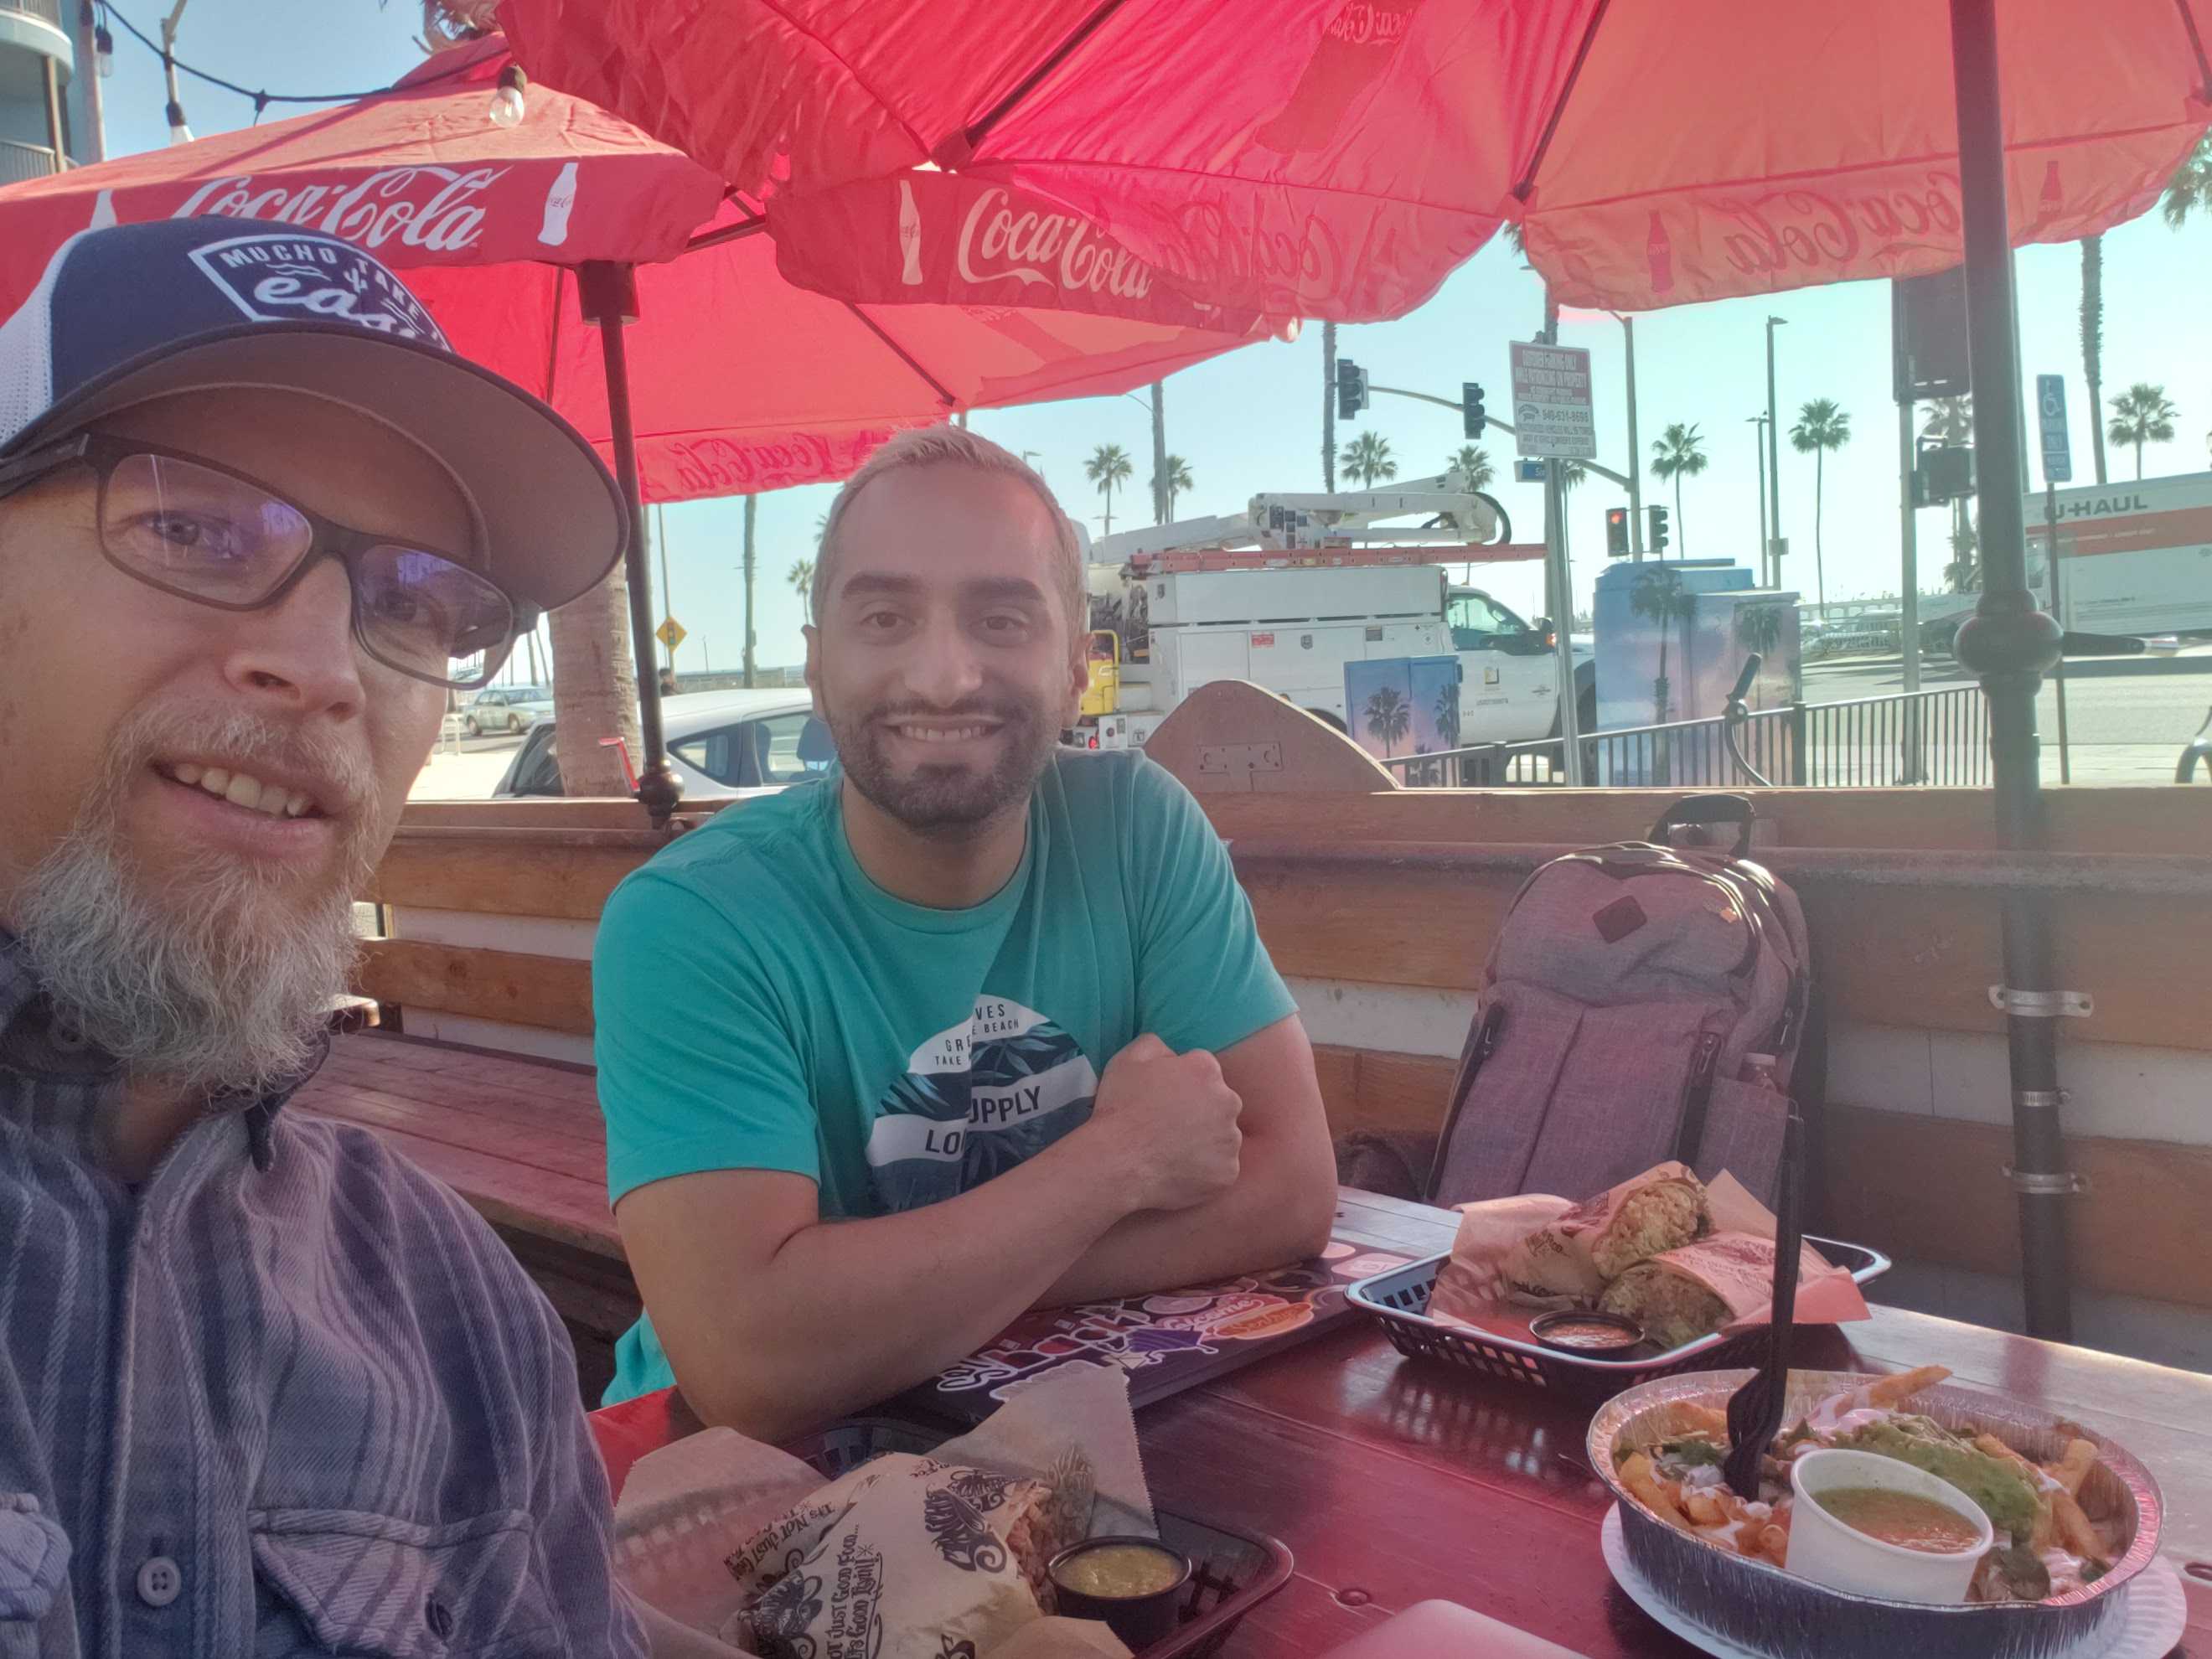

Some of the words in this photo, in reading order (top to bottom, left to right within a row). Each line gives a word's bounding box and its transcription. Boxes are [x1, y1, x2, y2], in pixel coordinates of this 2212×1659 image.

[171, 166, 513, 251] Coca-Cola
[219, 244, 338, 269] MUCHO
[355, 258, 421, 321] TAKE
[2044, 495, 2148, 521] U-HAUL
[984, 1018, 1020, 1034] BEACH
[935, 1056, 962, 1067] TAKE
